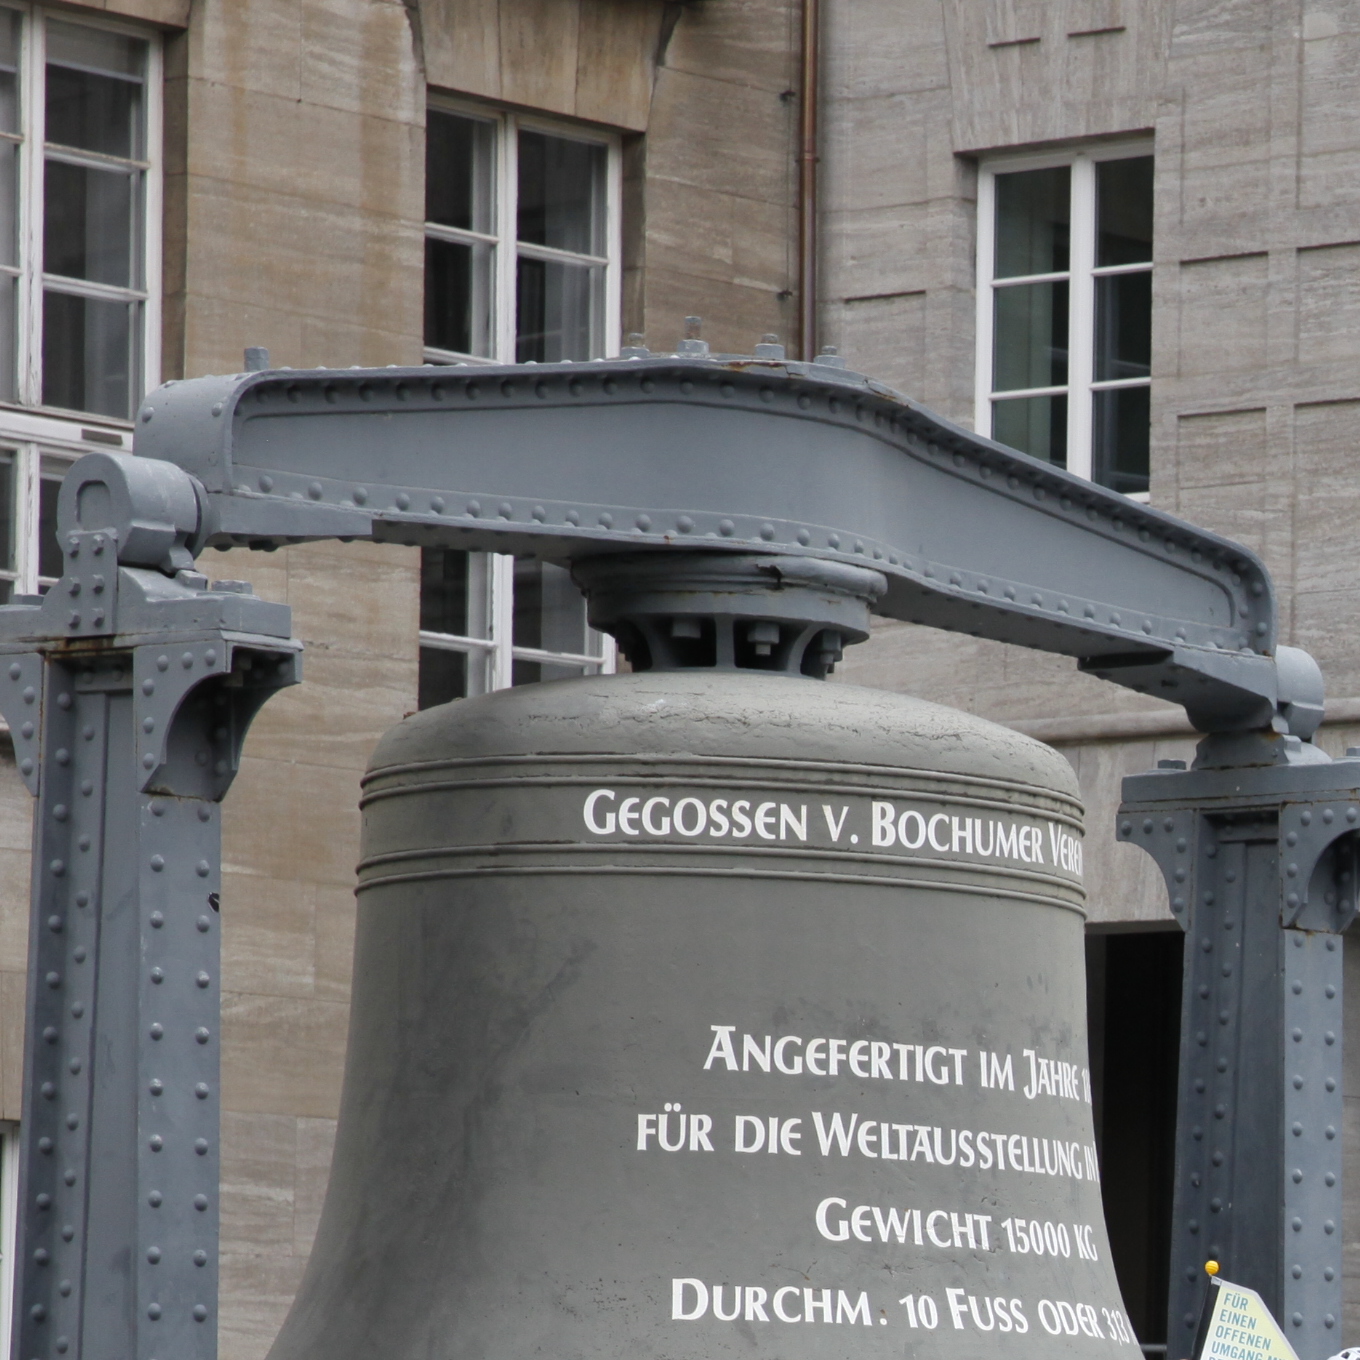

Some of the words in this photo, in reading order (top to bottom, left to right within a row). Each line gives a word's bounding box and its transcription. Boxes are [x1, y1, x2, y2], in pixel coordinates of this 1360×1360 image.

[979, 1050, 1015, 1091] IM
[637, 1103, 714, 1152] FÜR
[735, 1115, 802, 1156] DIE
[1001, 1217, 1070, 1259] 15000
[898, 1293, 938, 1329] 10
[1219, 1309, 1257, 1330] EINEN
[1223, 1292, 1249, 1311] FÜR
[1215, 1325, 1271, 1351] OFFENEN
